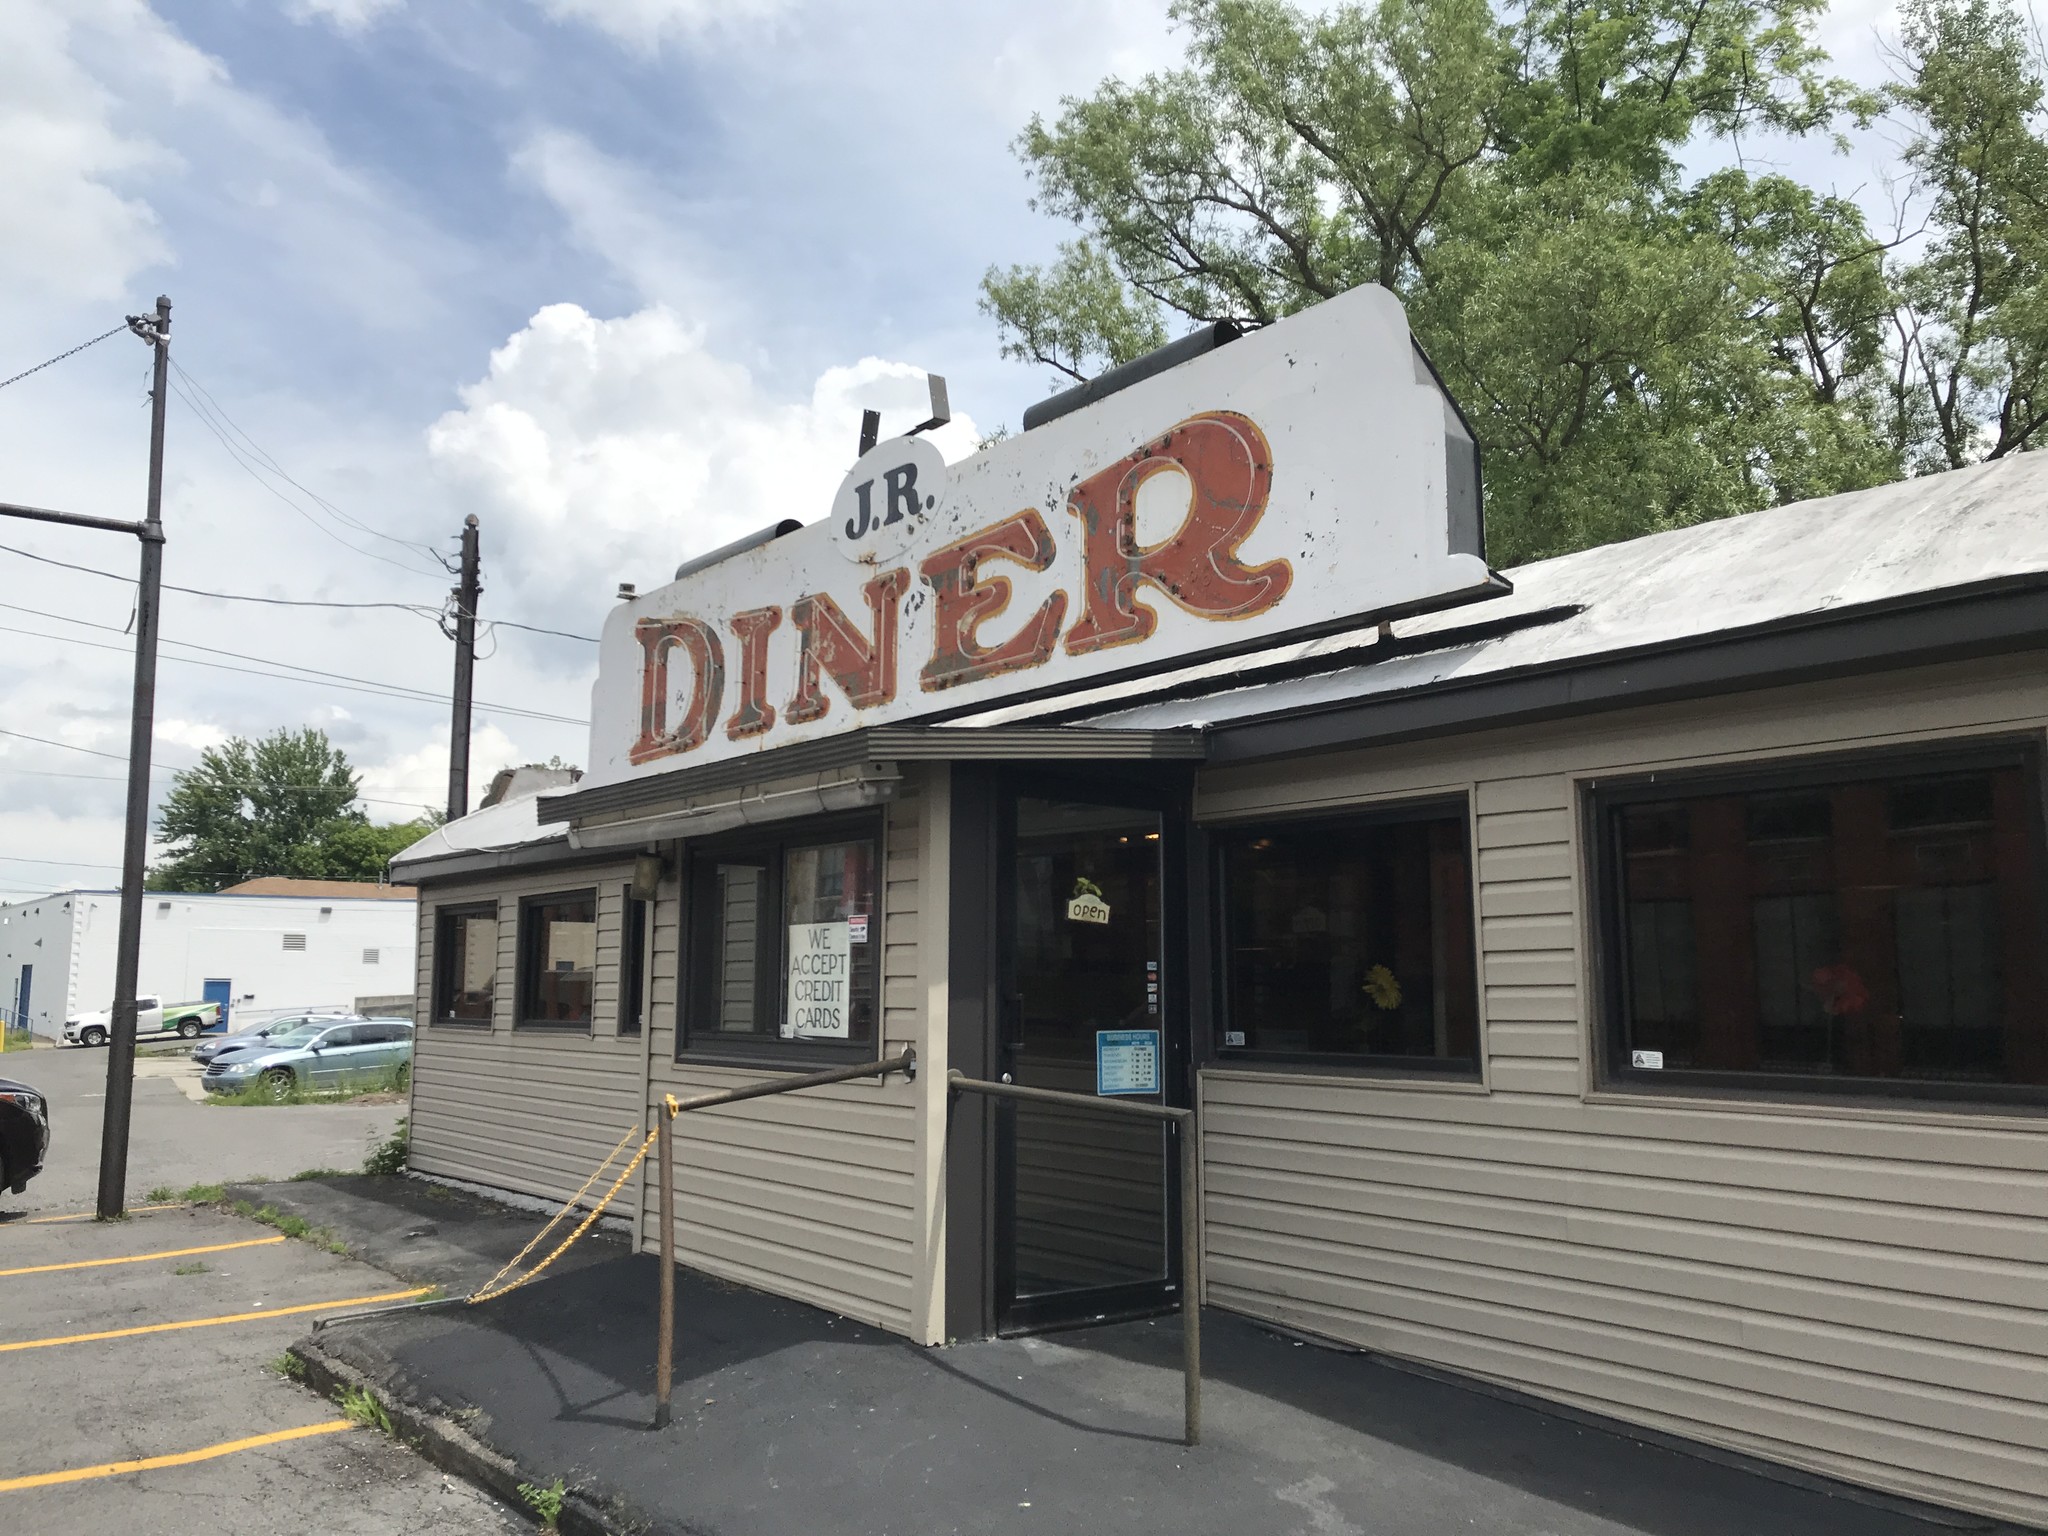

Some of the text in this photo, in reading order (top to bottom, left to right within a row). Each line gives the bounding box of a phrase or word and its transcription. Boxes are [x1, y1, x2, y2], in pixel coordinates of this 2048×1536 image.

[845, 462, 936, 540] J.R.
[627, 410, 1293, 766] DINER
[1073, 904, 1106, 921] open
[808, 928, 831, 950] WE
[791, 953, 847, 976] ACCEPT
[794, 980, 844, 1002] CREDIT
[795, 1007, 841, 1029] CARDS
